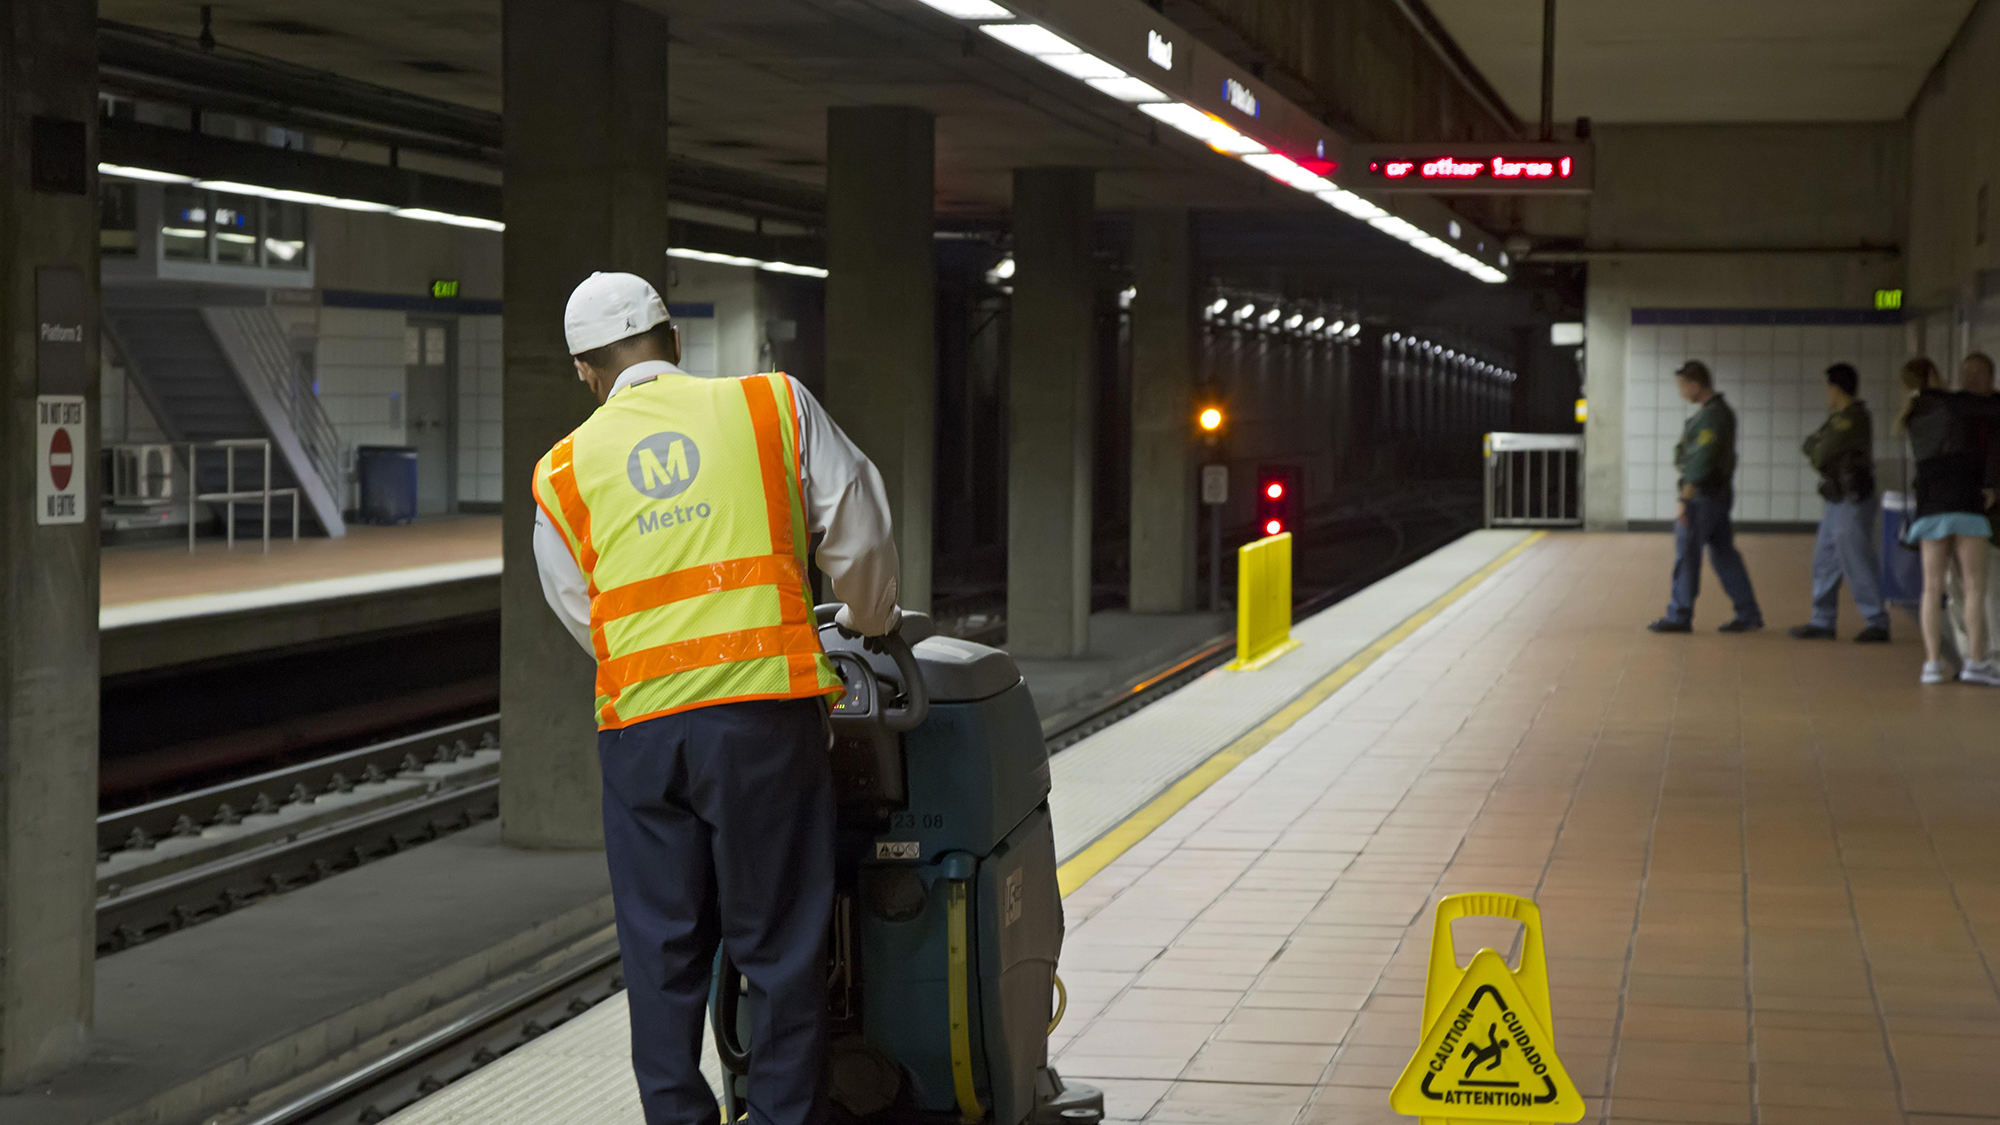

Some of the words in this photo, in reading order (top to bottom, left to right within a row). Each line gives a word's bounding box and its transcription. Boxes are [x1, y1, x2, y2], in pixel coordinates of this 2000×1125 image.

[1385, 162, 1414, 178] or
[1421, 157, 1485, 178] other
[1875, 289, 1902, 310] EXIT
[41, 322, 75, 341] Platform
[76, 324, 82, 342] 2
[40, 402, 49, 424] DO
[50, 402, 62, 424] NOT
[63, 402, 82, 424] ENTER
[47, 494, 56, 517] NO
[57, 494, 75, 517] ENTRE
[637, 502, 711, 535] Metro
[922, 813, 944, 830] 08
[1428, 1008, 1474, 1072] CAUTION
[1502, 1010, 1547, 1076] CUIDADO
[1444, 1089, 1533, 1106] ATTENTION
